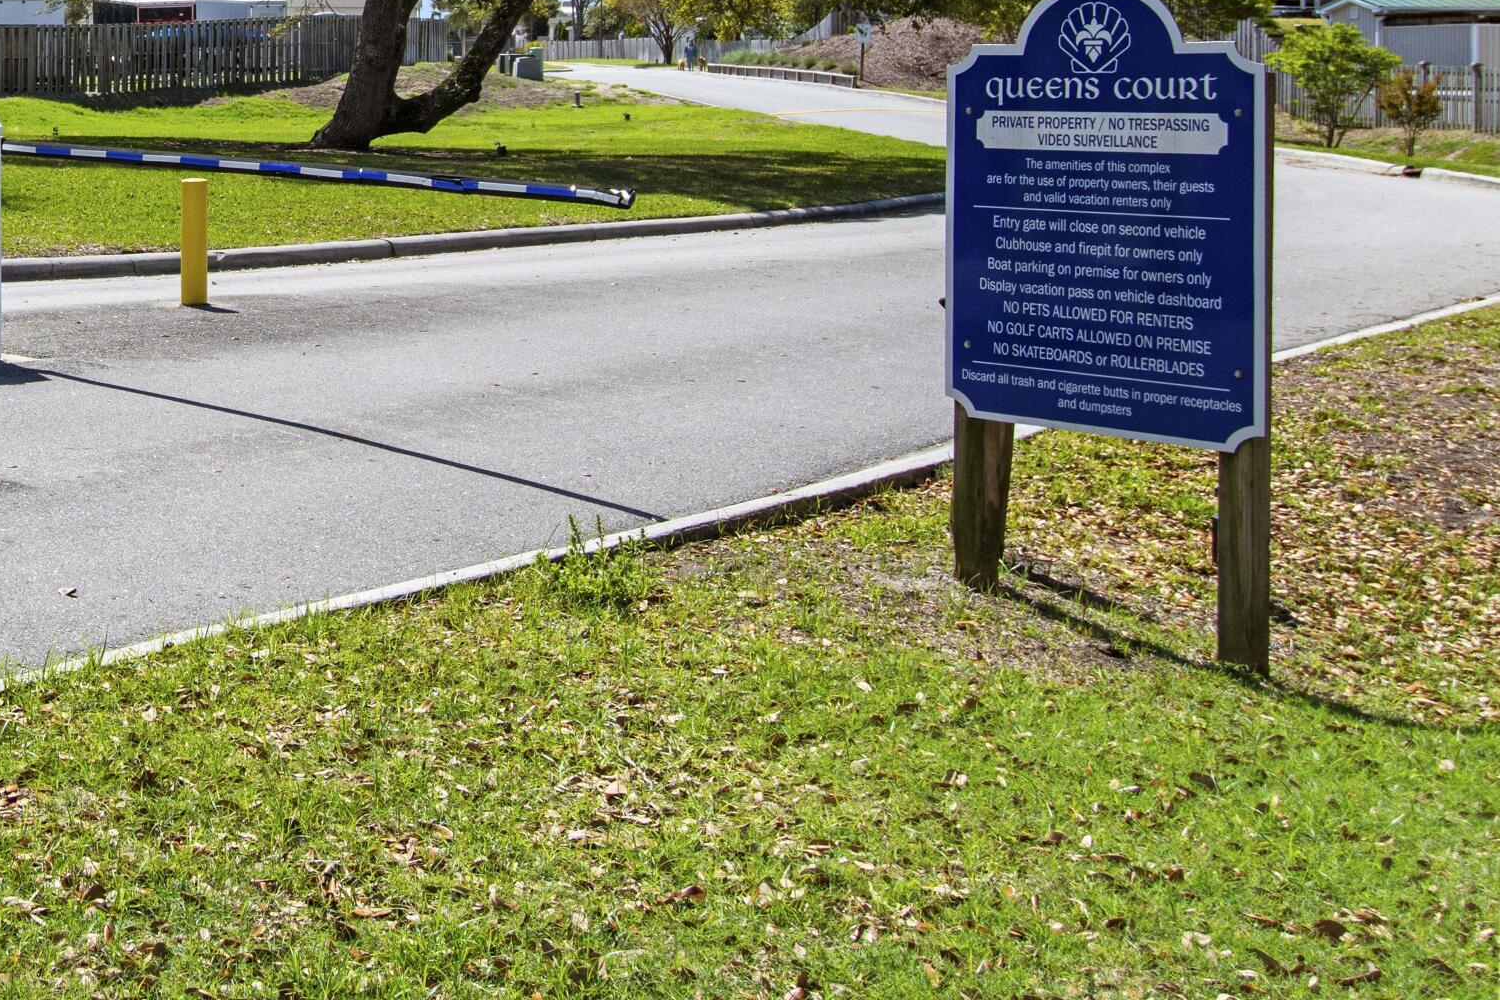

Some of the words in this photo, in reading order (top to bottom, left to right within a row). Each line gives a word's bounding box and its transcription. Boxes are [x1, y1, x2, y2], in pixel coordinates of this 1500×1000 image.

[992, 116, 1034, 129] PRIVATE
[1038, 117, 1096, 130] PROPERTY
[1109, 118, 1125, 131] NO
[1128, 118, 1210, 132] TRESPASSING
[1038, 134, 1071, 146] VIDEO
[1074, 134, 1158, 148] SURVEILLANCE
[1026, 158, 1042, 169] The
[1045, 159, 1092, 171] amenities
[1095, 160, 1105, 172] of
[1108, 161, 1126, 172] this
[1128, 162, 1171, 175] complex
[987, 174, 1002, 184] are
[1004, 173, 1017, 185] for
[1020, 175, 1035, 186] the
[1038, 177, 1054, 186] use
[1057, 176, 1067, 186] of
[1069, 178, 1109, 191] property
[1112, 180, 1150, 191] owners,
[1153, 180, 1177, 191] their
[1179, 182, 1215, 194] guests
[1024, 192, 1041, 202] and
[1044, 192, 1066, 203] valid
[1069, 194, 1110, 205] vacation
[1112, 197, 1148, 208] renters
[1151, 197, 1172, 211] only
[993, 215, 1020, 231] Entry
[1023, 219, 1046, 232] gate
[1049, 219, 1066, 231] will
[1070, 220, 1098, 233] close
[1101, 224, 1115, 234] on
[1119, 224, 1160, 237] second
[1164, 225, 1206, 239] vehicle
[996, 237, 1051, 252] Clubhouse
[1055, 242, 1075, 254] and
[1079, 242, 1112, 258] firepit
[1115, 244, 1130, 257] for
[1133, 247, 1175, 260] owners
[1179, 249, 1203, 265] only
[988, 257, 1012, 271] Boat
[1015, 261, 1055, 277] parking
[1058, 265, 1071, 275] on
[1075, 265, 1119, 279] premise
[1123, 267, 1139, 280] for
[1141, 271, 1184, 284] owners
[1187, 273, 1212, 289] only
[980, 278, 1017, 295] Display
[1020, 283, 1065, 296] vacation
[1068, 288, 1094, 300] pass
[1097, 290, 1111, 300] on
[1114, 289, 1155, 304] vehicle
[1158, 293, 1222, 310] dashboard
[1004, 301, 1019, 314] NO
[1023, 302, 1050, 317] PETS
[1053, 305, 1107, 322] ALLOWED
[1111, 310, 1133, 324] FOR
[1137, 313, 1194, 330] RENTERS
[988, 321, 1003, 333] NO
[1006, 322, 1035, 337] GOLF
[1038, 325, 1074, 341] CARTS
[1077, 329, 1131, 346] ALLOWED
[1135, 335, 1153, 349] ON
[1157, 337, 1212, 355] PREMISE
[994, 342, 1009, 355] NO
[1012, 344, 1093, 365] SKATEBOARDS
[1096, 355, 1107, 366] or
[1111, 355, 1204, 377] ROLLERBLADES
[962, 369, 995, 383] Discard
[998, 373, 1009, 384] all
[1012, 375, 1035, 387] trash
[1038, 379, 1056, 390] and
[1058, 381, 1101, 395] cigarette
[1103, 386, 1129, 399] butts
[1132, 389, 1141, 400] in
[1144, 392, 1178, 405] proper
[1180, 396, 1242, 413] receptacles
[1058, 399, 1076, 409] and
[1079, 400, 1132, 416] dumpsters
